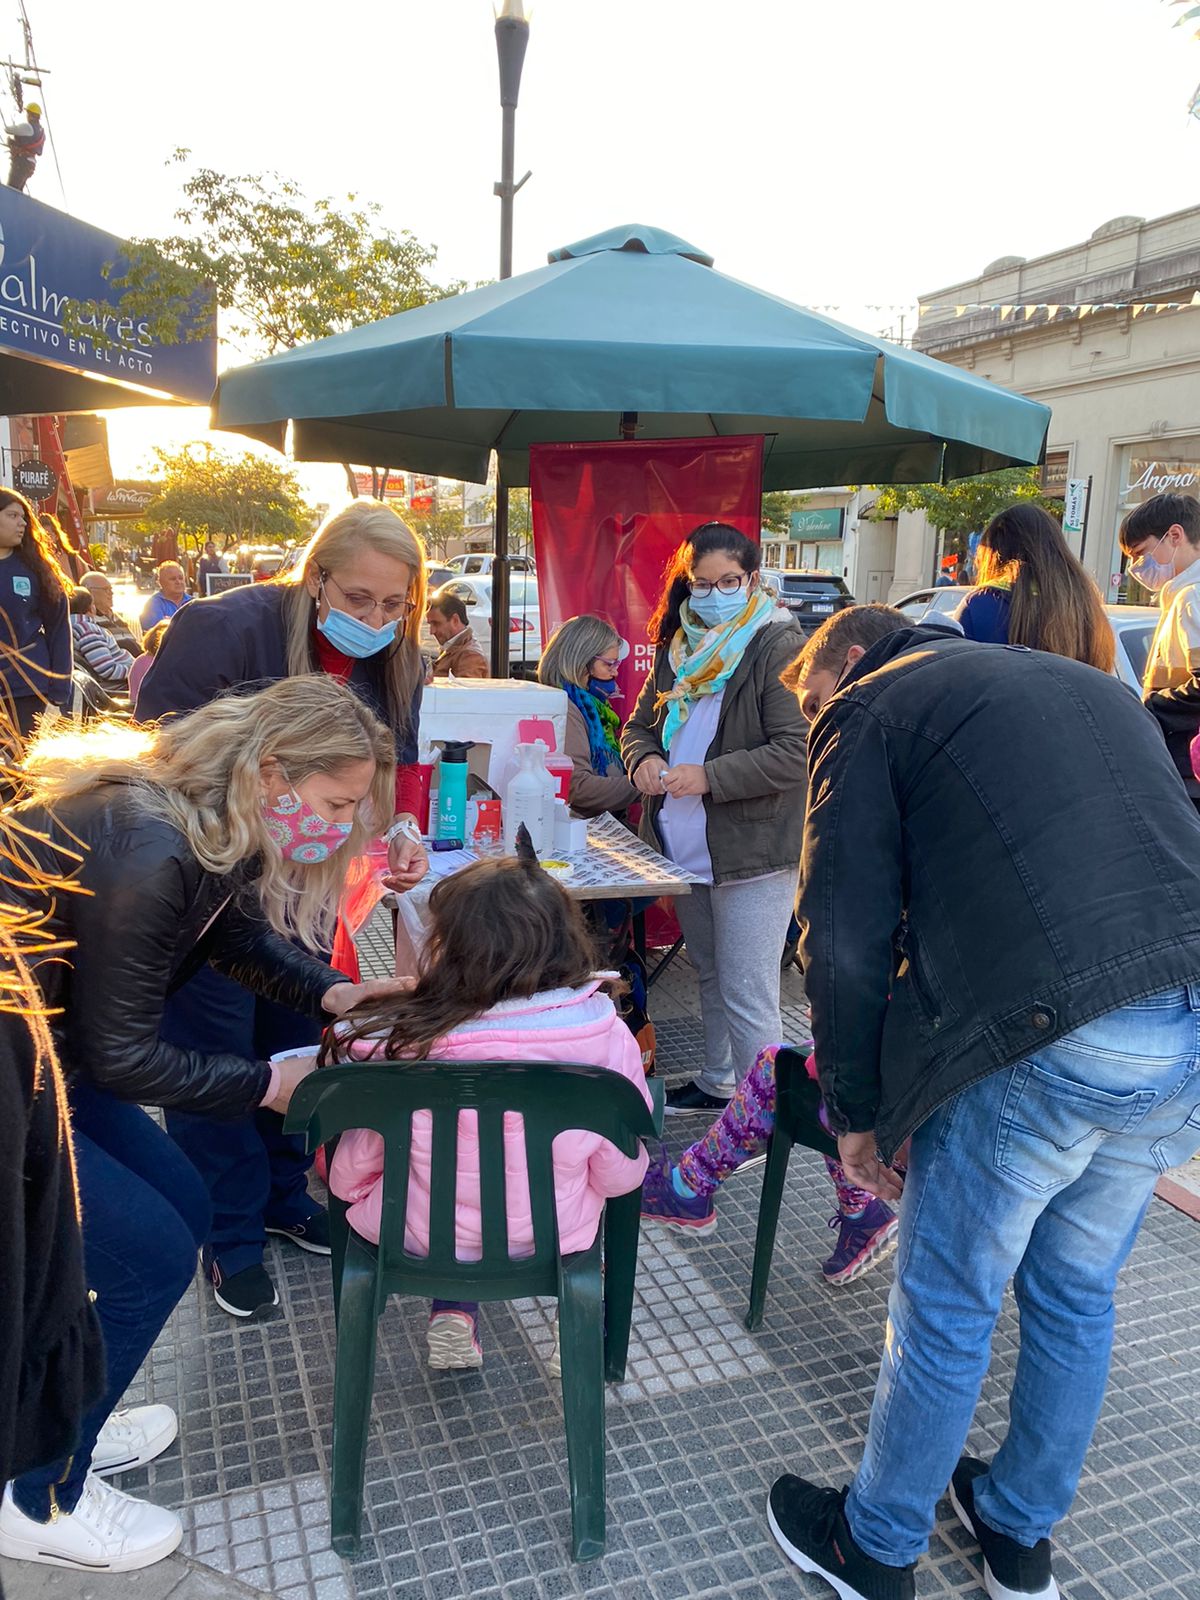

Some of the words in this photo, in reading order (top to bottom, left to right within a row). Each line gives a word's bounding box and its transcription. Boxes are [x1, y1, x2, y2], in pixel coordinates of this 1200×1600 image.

[69, 338, 86, 355] EN
[96, 347, 111, 362] EL
[119, 354, 152, 374] ACTO
[20, 470, 49, 485] PURAFÉ
[1120, 461, 1195, 493] Angra
[440, 814, 457, 823] NO
